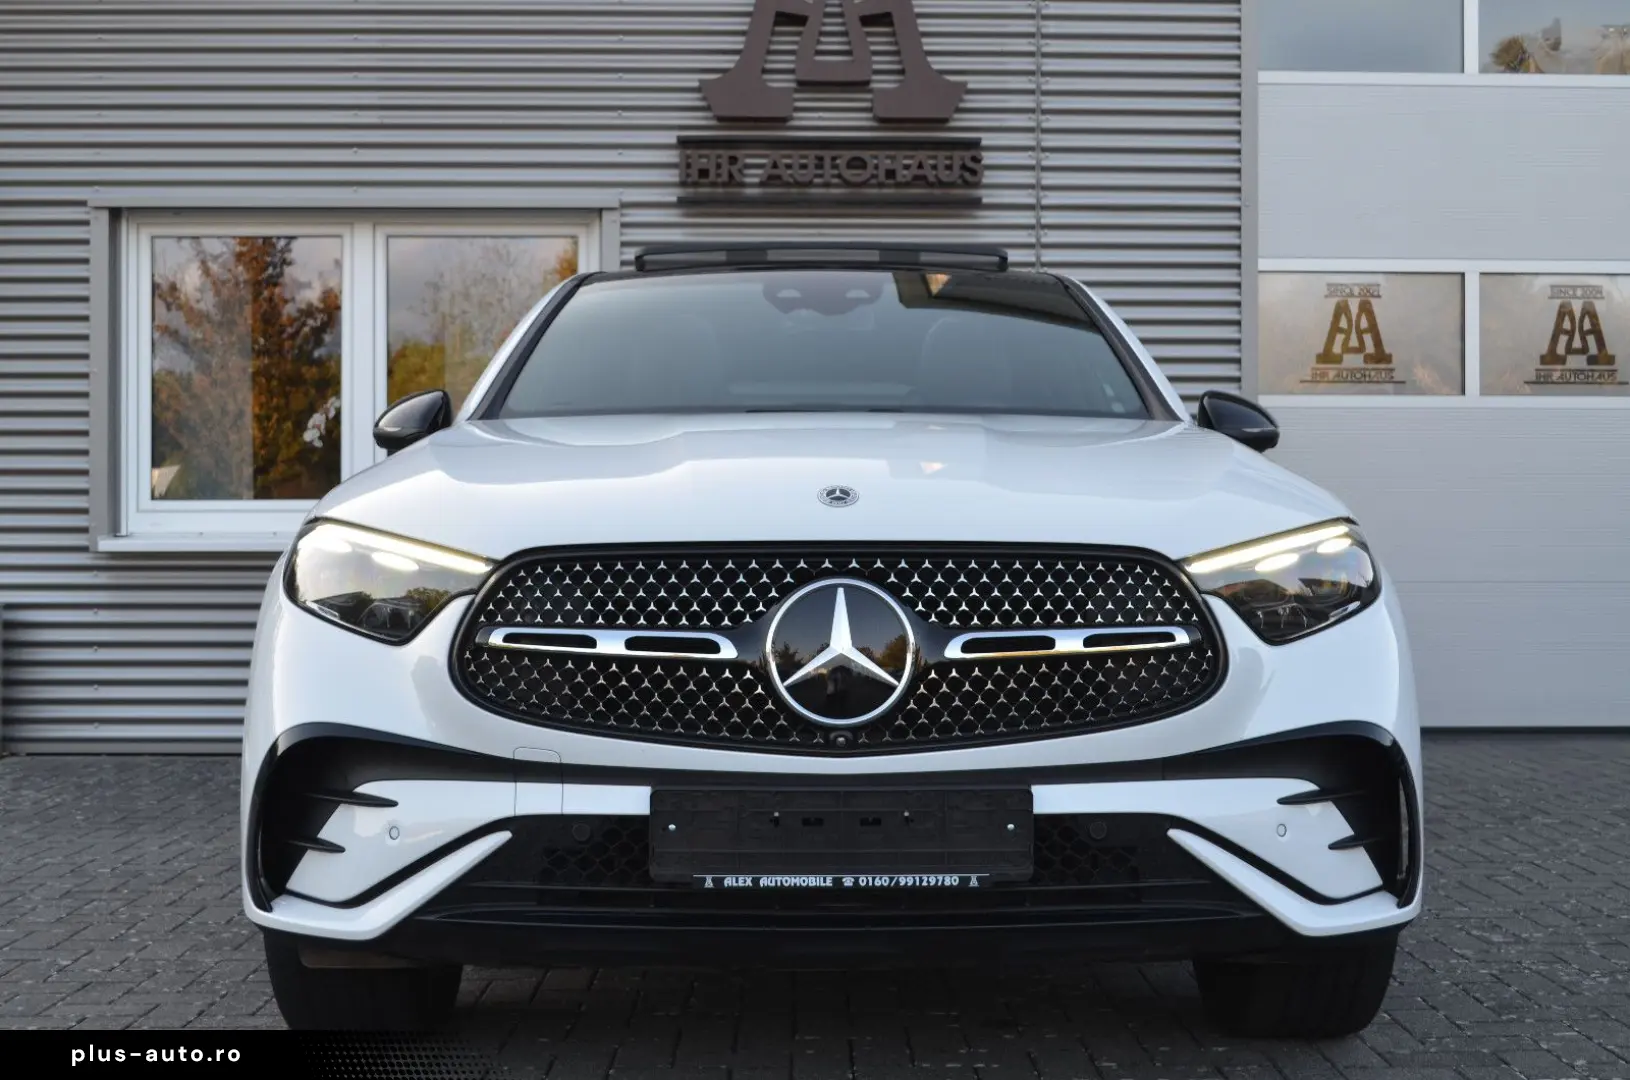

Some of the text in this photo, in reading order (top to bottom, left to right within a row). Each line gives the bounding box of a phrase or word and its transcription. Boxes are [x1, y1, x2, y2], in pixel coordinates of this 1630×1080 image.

[679, 150, 984, 187] IHR AUTOHAUS
[723, 876, 753, 888] ALEX
[759, 876, 833, 887] AUTOMOBILE
[858, 875, 960, 887] 0160/99129780
